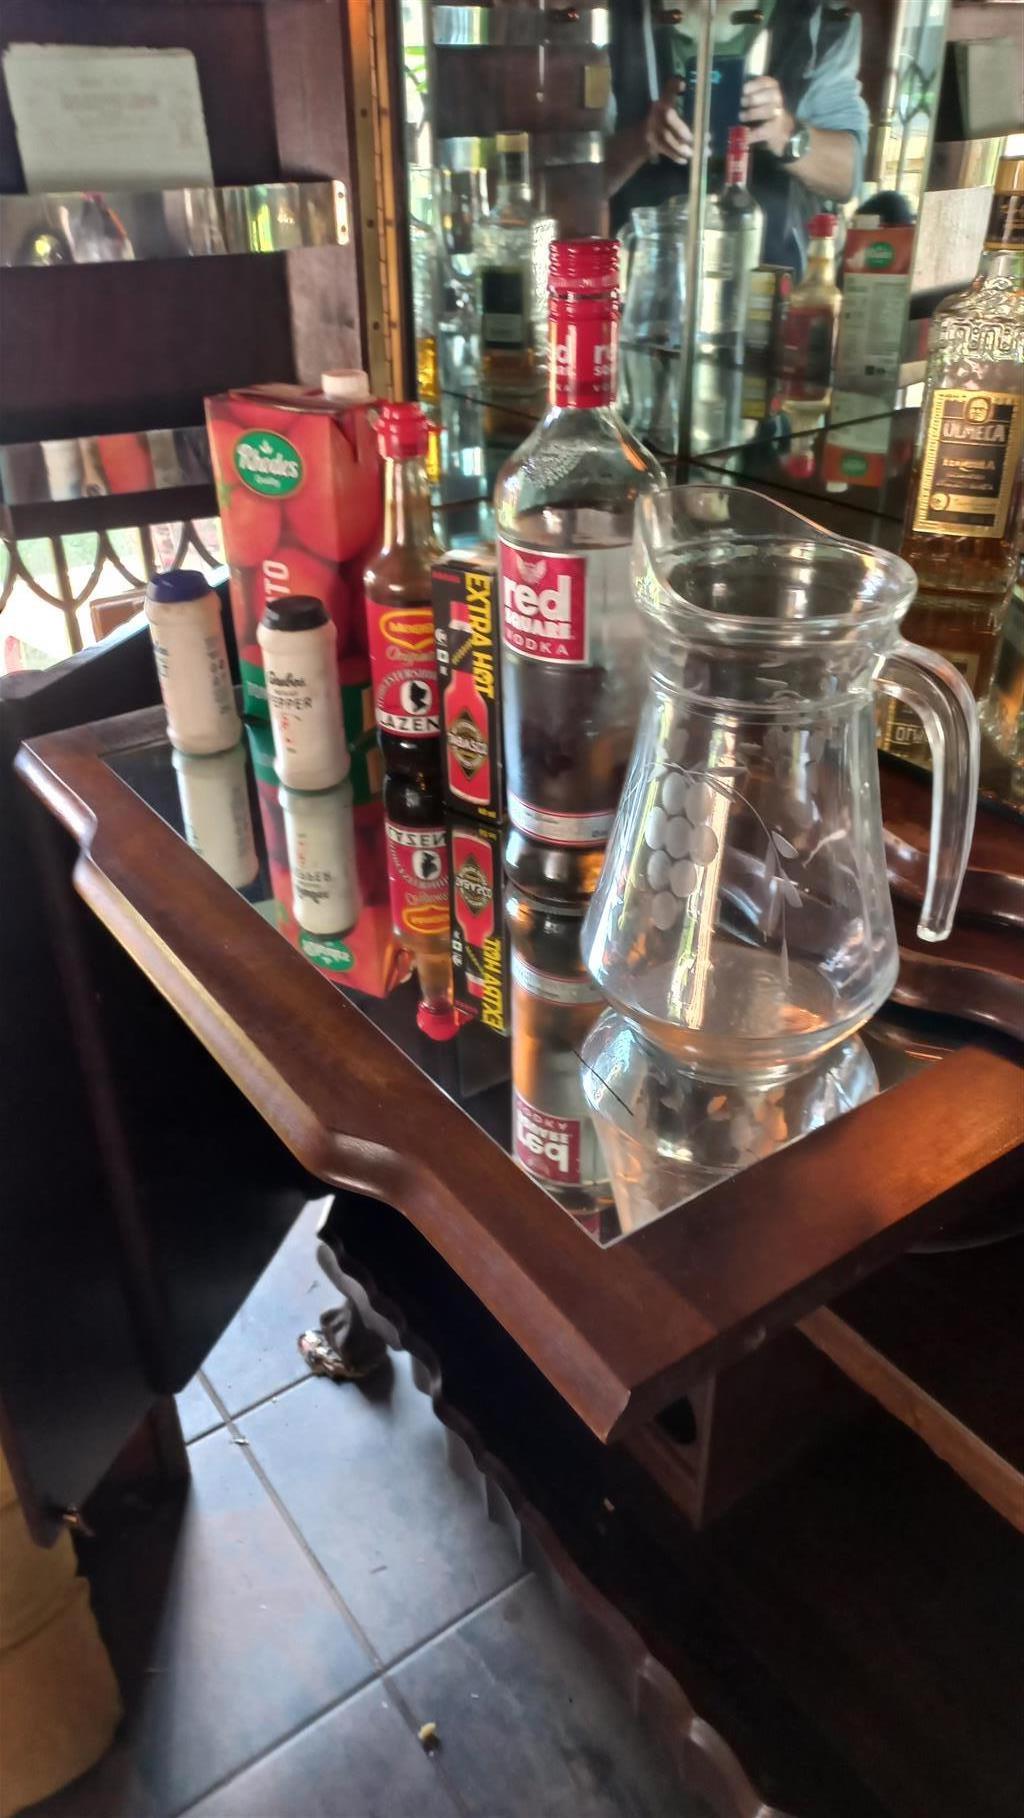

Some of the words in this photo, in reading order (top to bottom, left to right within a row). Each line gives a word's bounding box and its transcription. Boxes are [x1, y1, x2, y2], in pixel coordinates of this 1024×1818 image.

[236, 443, 299, 479] Rhodes
[465, 571, 493, 647] EXTRA
[503, 574, 572, 624] red
[506, 628, 569, 656] VODKA
[472, 650, 496, 701] HOT
